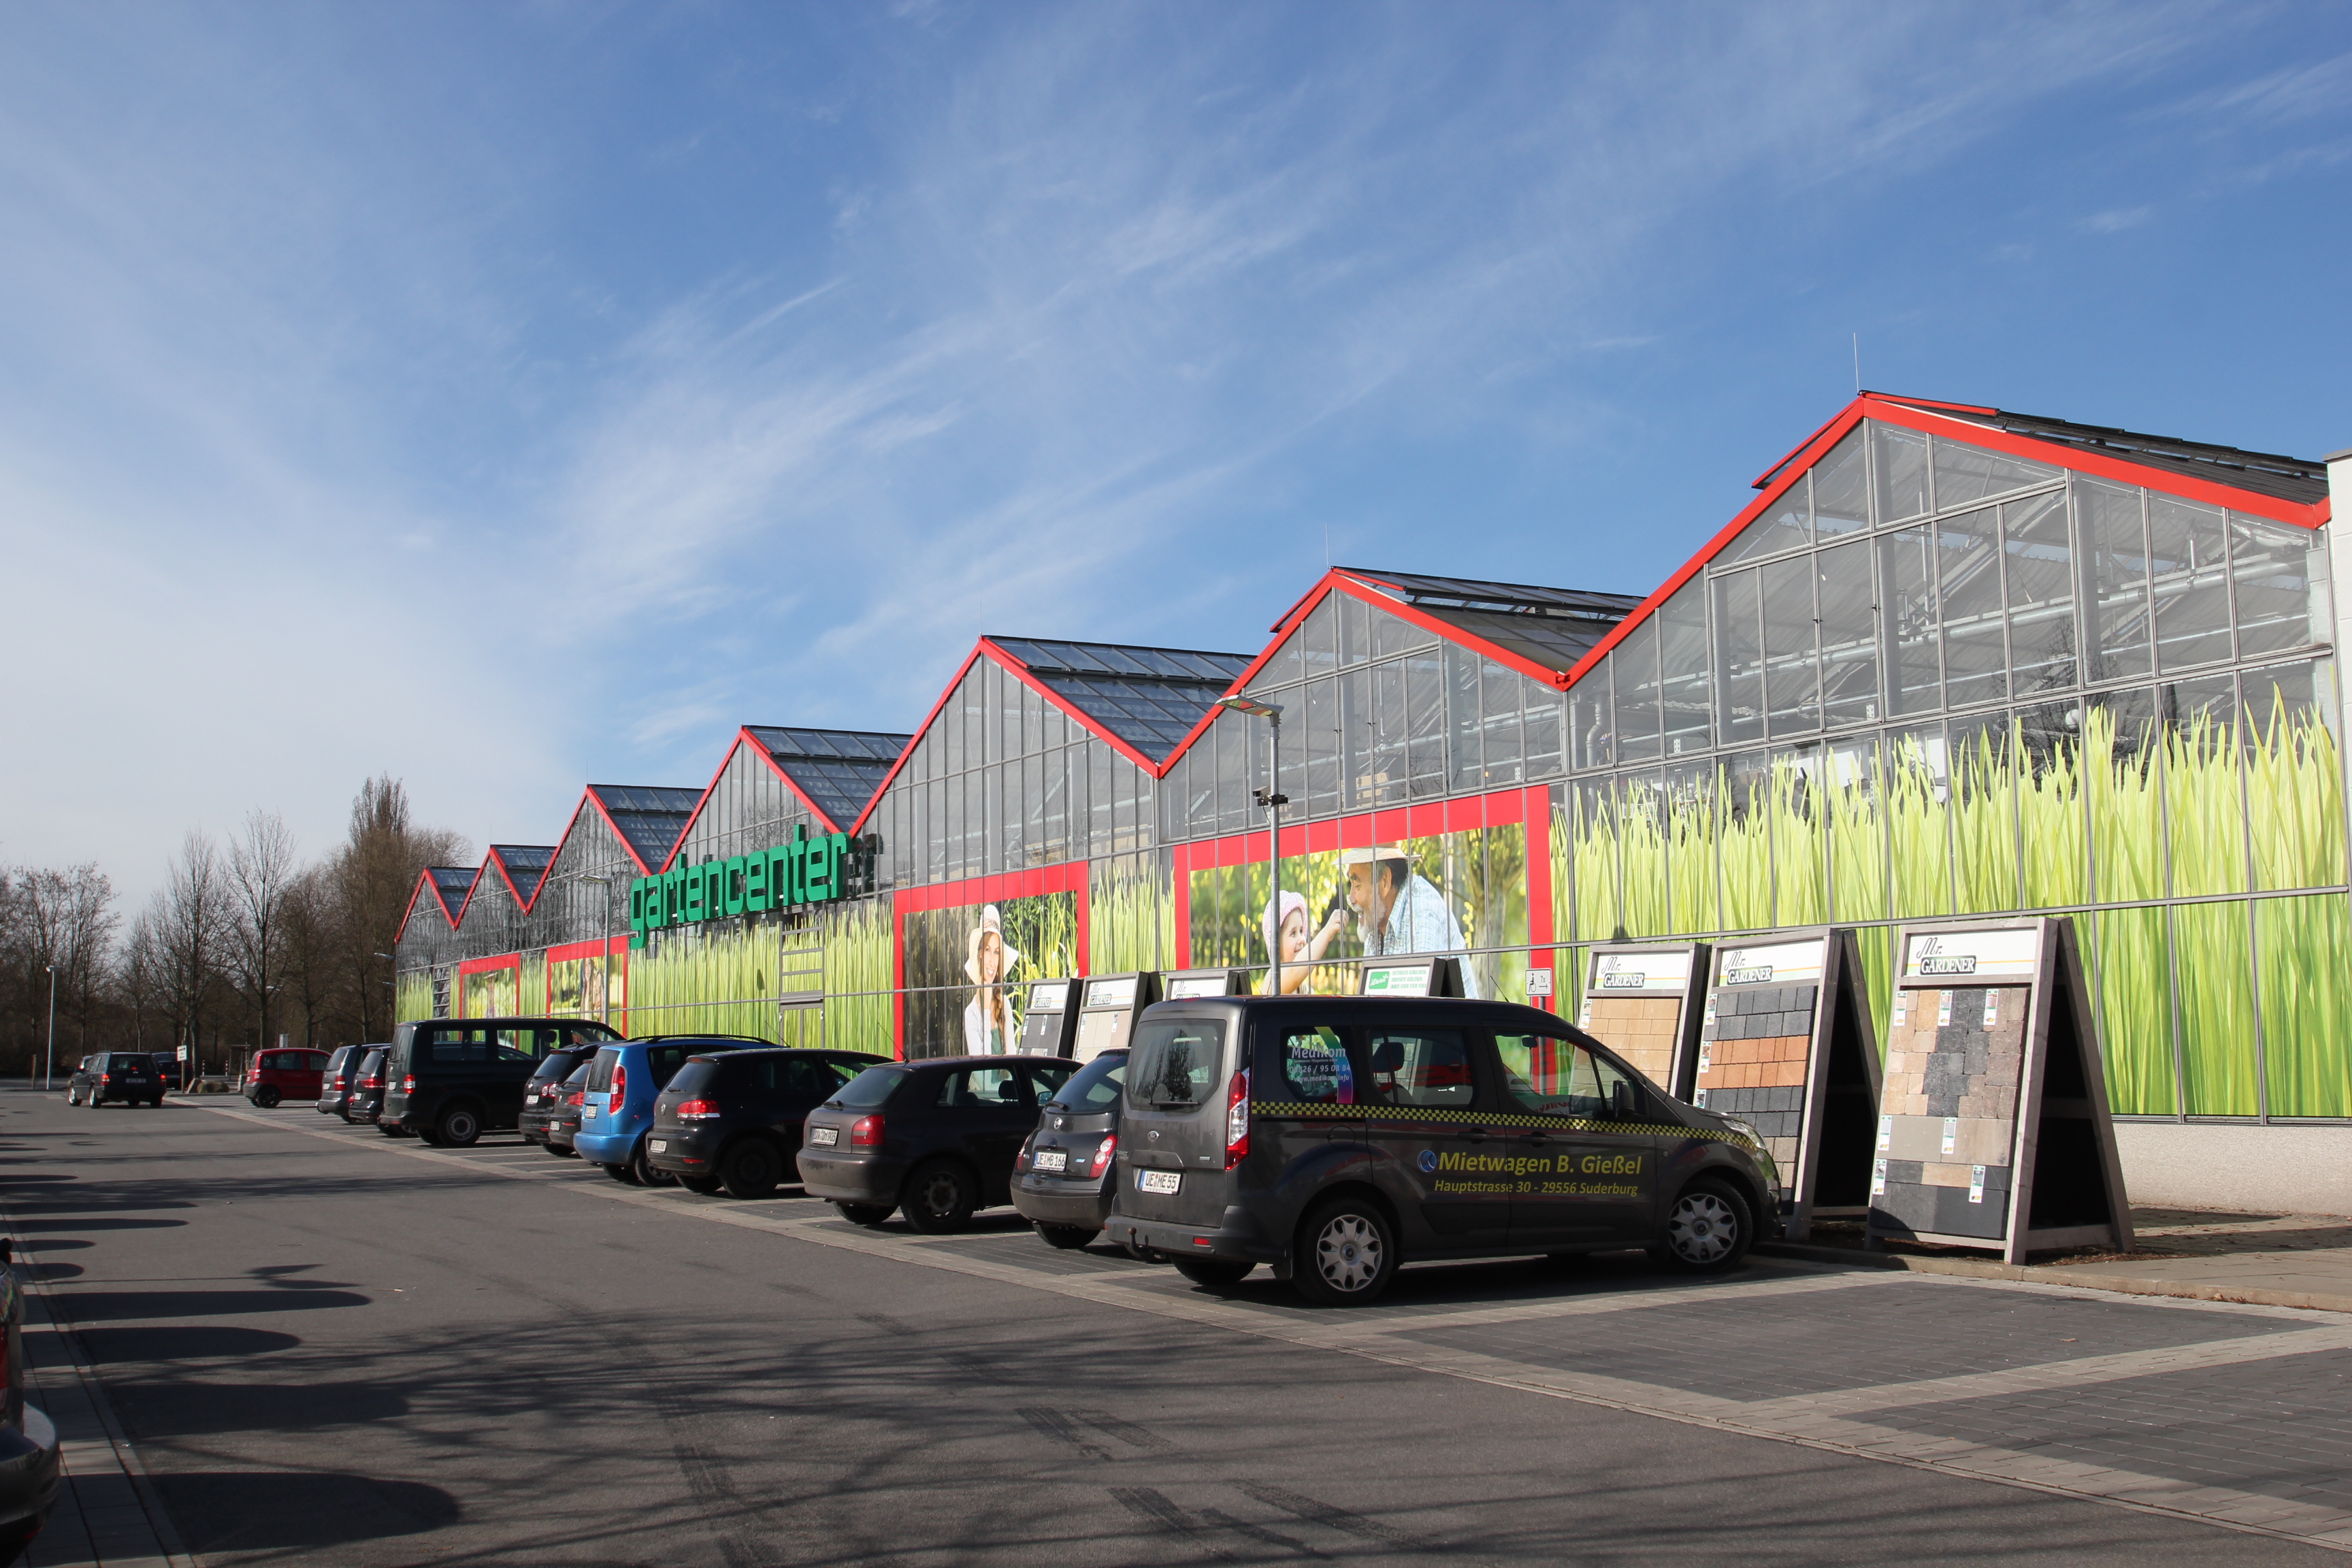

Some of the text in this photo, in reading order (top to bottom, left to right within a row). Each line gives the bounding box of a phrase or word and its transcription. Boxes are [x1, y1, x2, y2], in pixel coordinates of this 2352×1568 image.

[630, 823, 853, 949] gartencenter
[1916, 936, 1943, 958] Mr.
[1601, 956, 1621, 974] Mr.
[1724, 951, 1746, 970] Mr.
[1921, 958, 1975, 973] GARDENER
[1539, 975, 1546, 983] 7x
[1604, 974, 1644, 987] GARDENER
[1729, 967, 1771, 983] GARDENER
[1090, 995, 1111, 1005] GARDENER
[1292, 1046, 1345, 1058] Medikom
[1036, 1154, 1044, 1165] UE
[1054, 1155, 1066, 1167] 166
[1439, 1152, 1642, 1175] Mietwagen B. Gießel
[1145, 1173, 1177, 1189] UE ME 55
[1435, 1180, 1513, 1194] Hauptstrasse
[1516, 1181, 1531, 1193] 30
[1541, 1181, 1576, 1193] 29556
[1579, 1182, 1638, 1196] Suderburg
